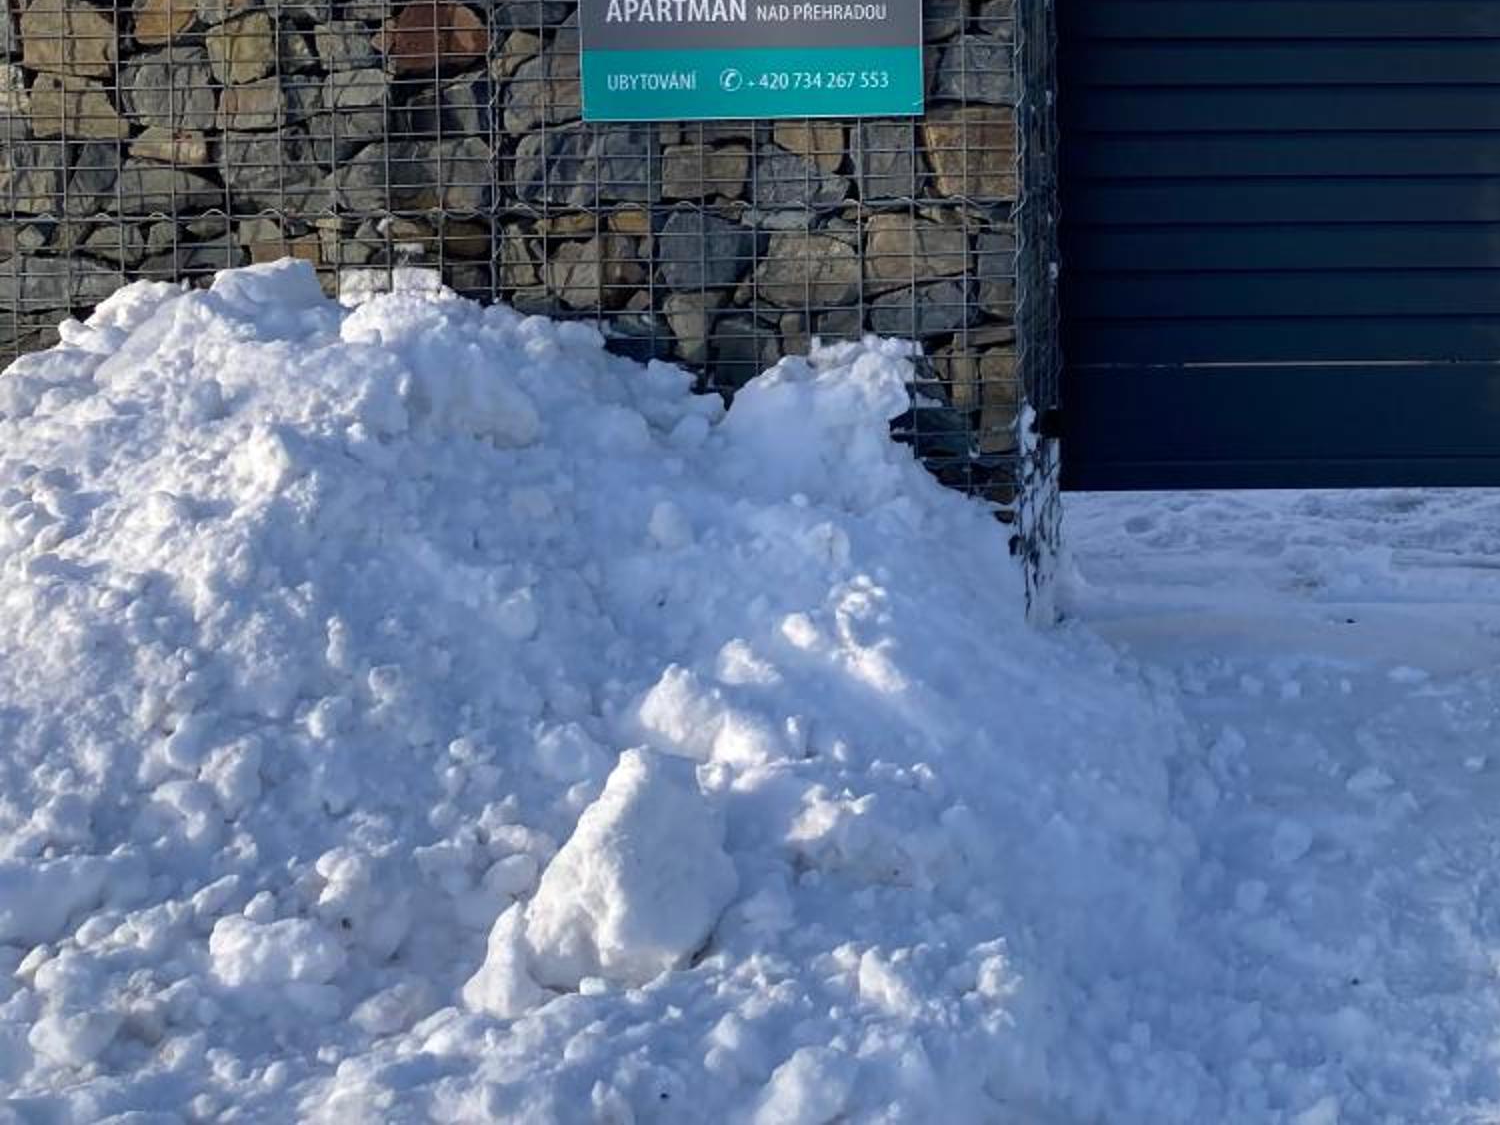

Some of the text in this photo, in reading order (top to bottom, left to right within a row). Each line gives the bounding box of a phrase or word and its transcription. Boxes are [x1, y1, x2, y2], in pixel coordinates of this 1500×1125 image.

[756, 4, 788, 21] NAD
[793, 1, 888, 21] PŘEHRADOU
[607, 70, 697, 91] UBYTOVÁNÍ
[794, 72, 823, 88] 734
[827, 72, 855, 88] 267
[860, 71, 889, 88] 553
